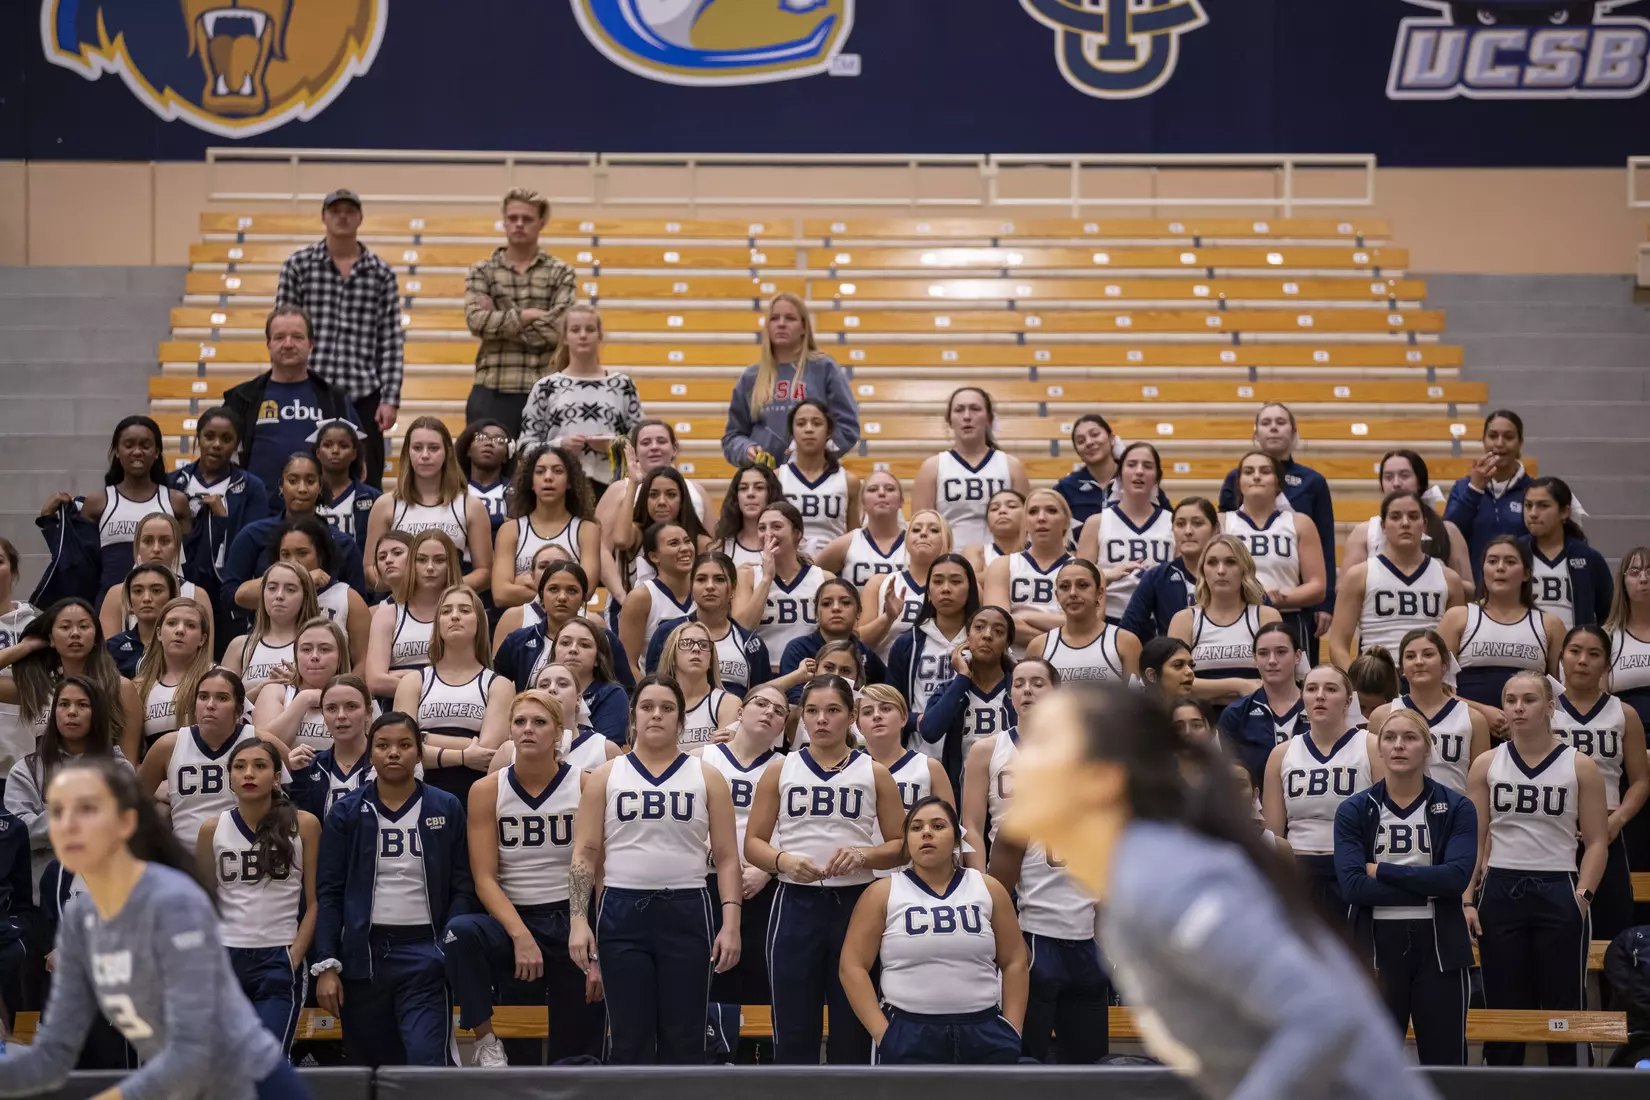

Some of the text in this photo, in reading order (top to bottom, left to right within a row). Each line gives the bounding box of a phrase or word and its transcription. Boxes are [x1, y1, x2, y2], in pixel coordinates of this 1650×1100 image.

[1399, 26, 1646, 89] UCSB
[774, 380, 807, 401] SA
[280, 399, 323, 421] cbu
[1107, 538, 1171, 563] CBU
[1011, 577, 1055, 603] CB
[1374, 590, 1441, 618] CBU
[1471, 641, 1540, 660] LANCERS
[420, 702, 486, 721] LANCERS
[177, 764, 233, 797] CB
[1287, 767, 1359, 798] CBU
[616, 790, 695, 823] CBU
[786, 785, 863, 819] CBU
[1493, 782, 1568, 816] CBU
[426, 816, 446, 827] CBU
[499, 813, 575, 848] CBU
[380, 827, 423, 858] BU
[904, 904, 983, 936] CBU
[1553, 1021, 1564, 1029] 12
